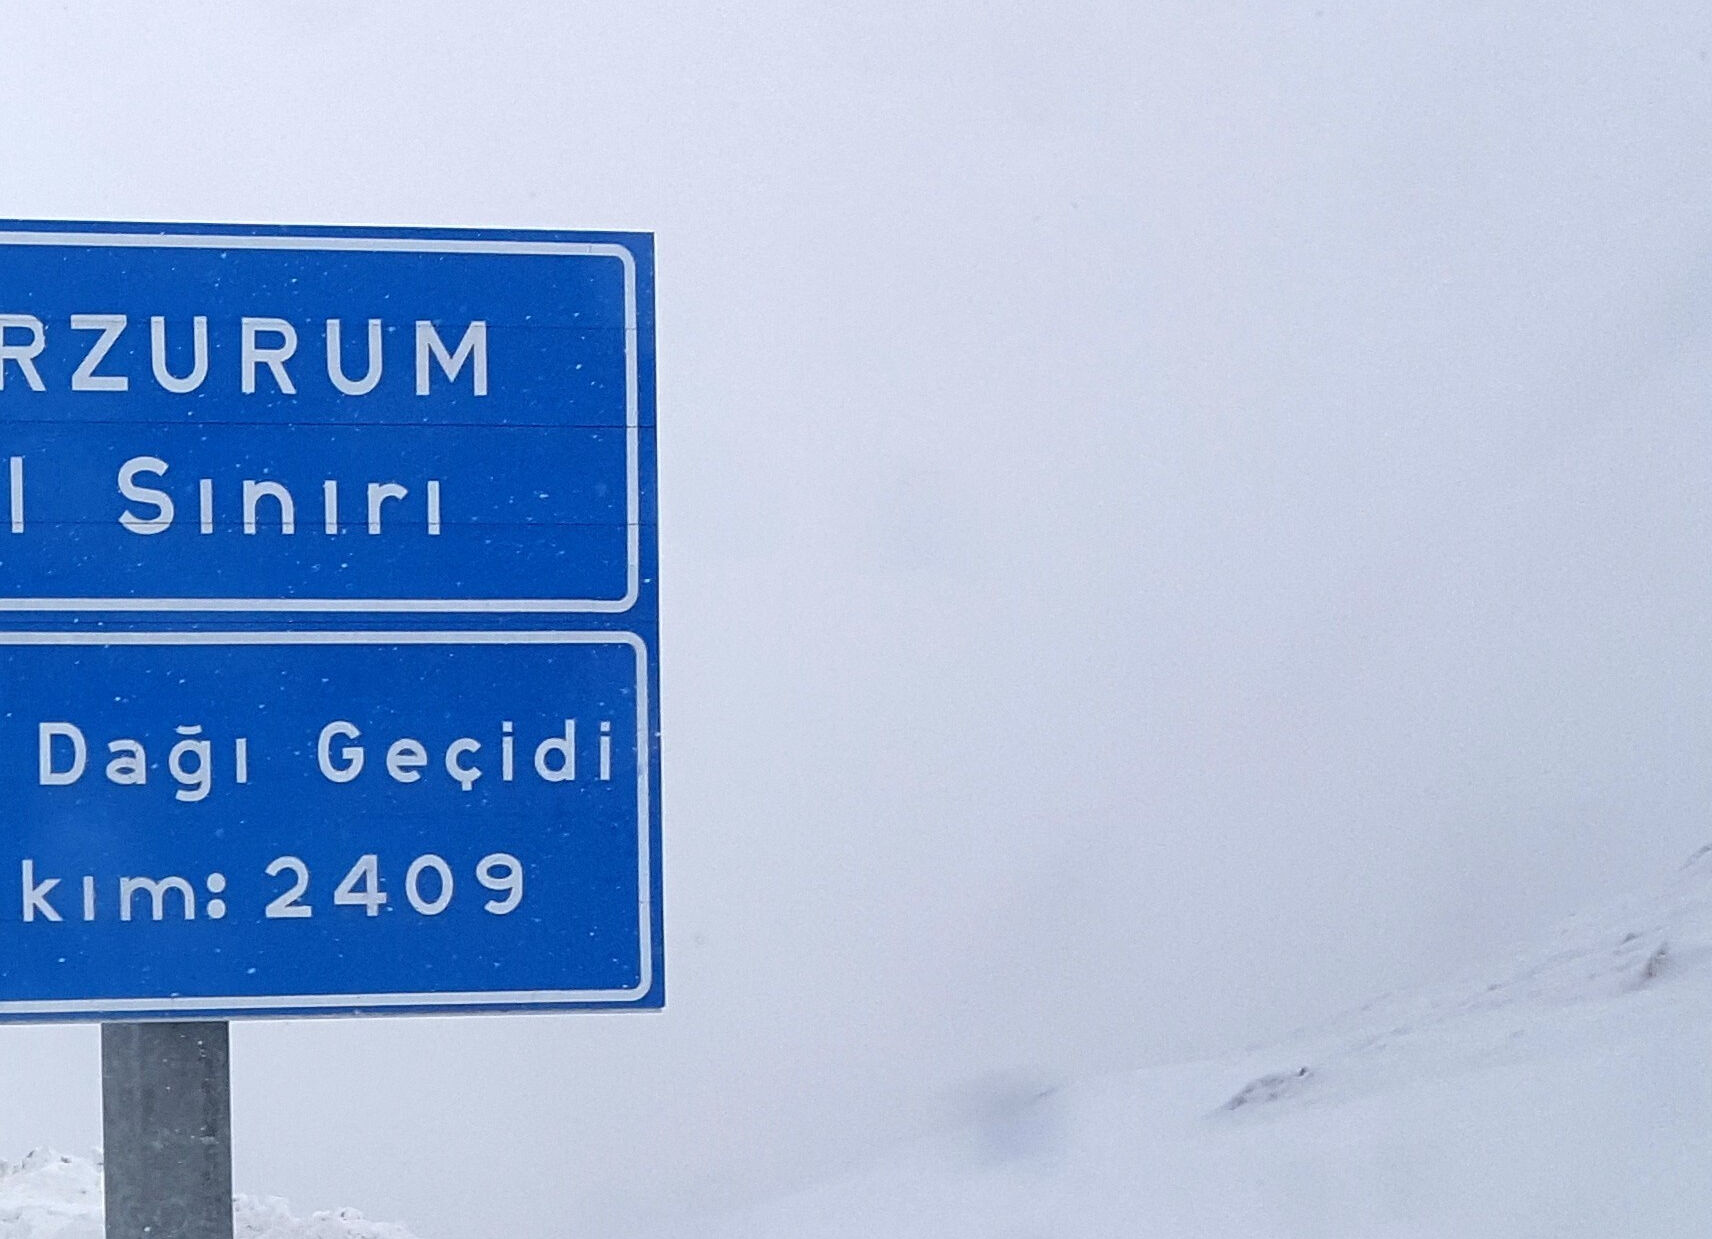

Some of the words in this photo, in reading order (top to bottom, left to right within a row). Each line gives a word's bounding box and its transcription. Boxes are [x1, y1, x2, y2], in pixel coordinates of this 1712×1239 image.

[118, 456, 440, 534] Sınırı
[40, 722, 247, 801] Dağı
[318, 719, 610, 790] Geçidi
[266, 853, 522, 917] 2409
